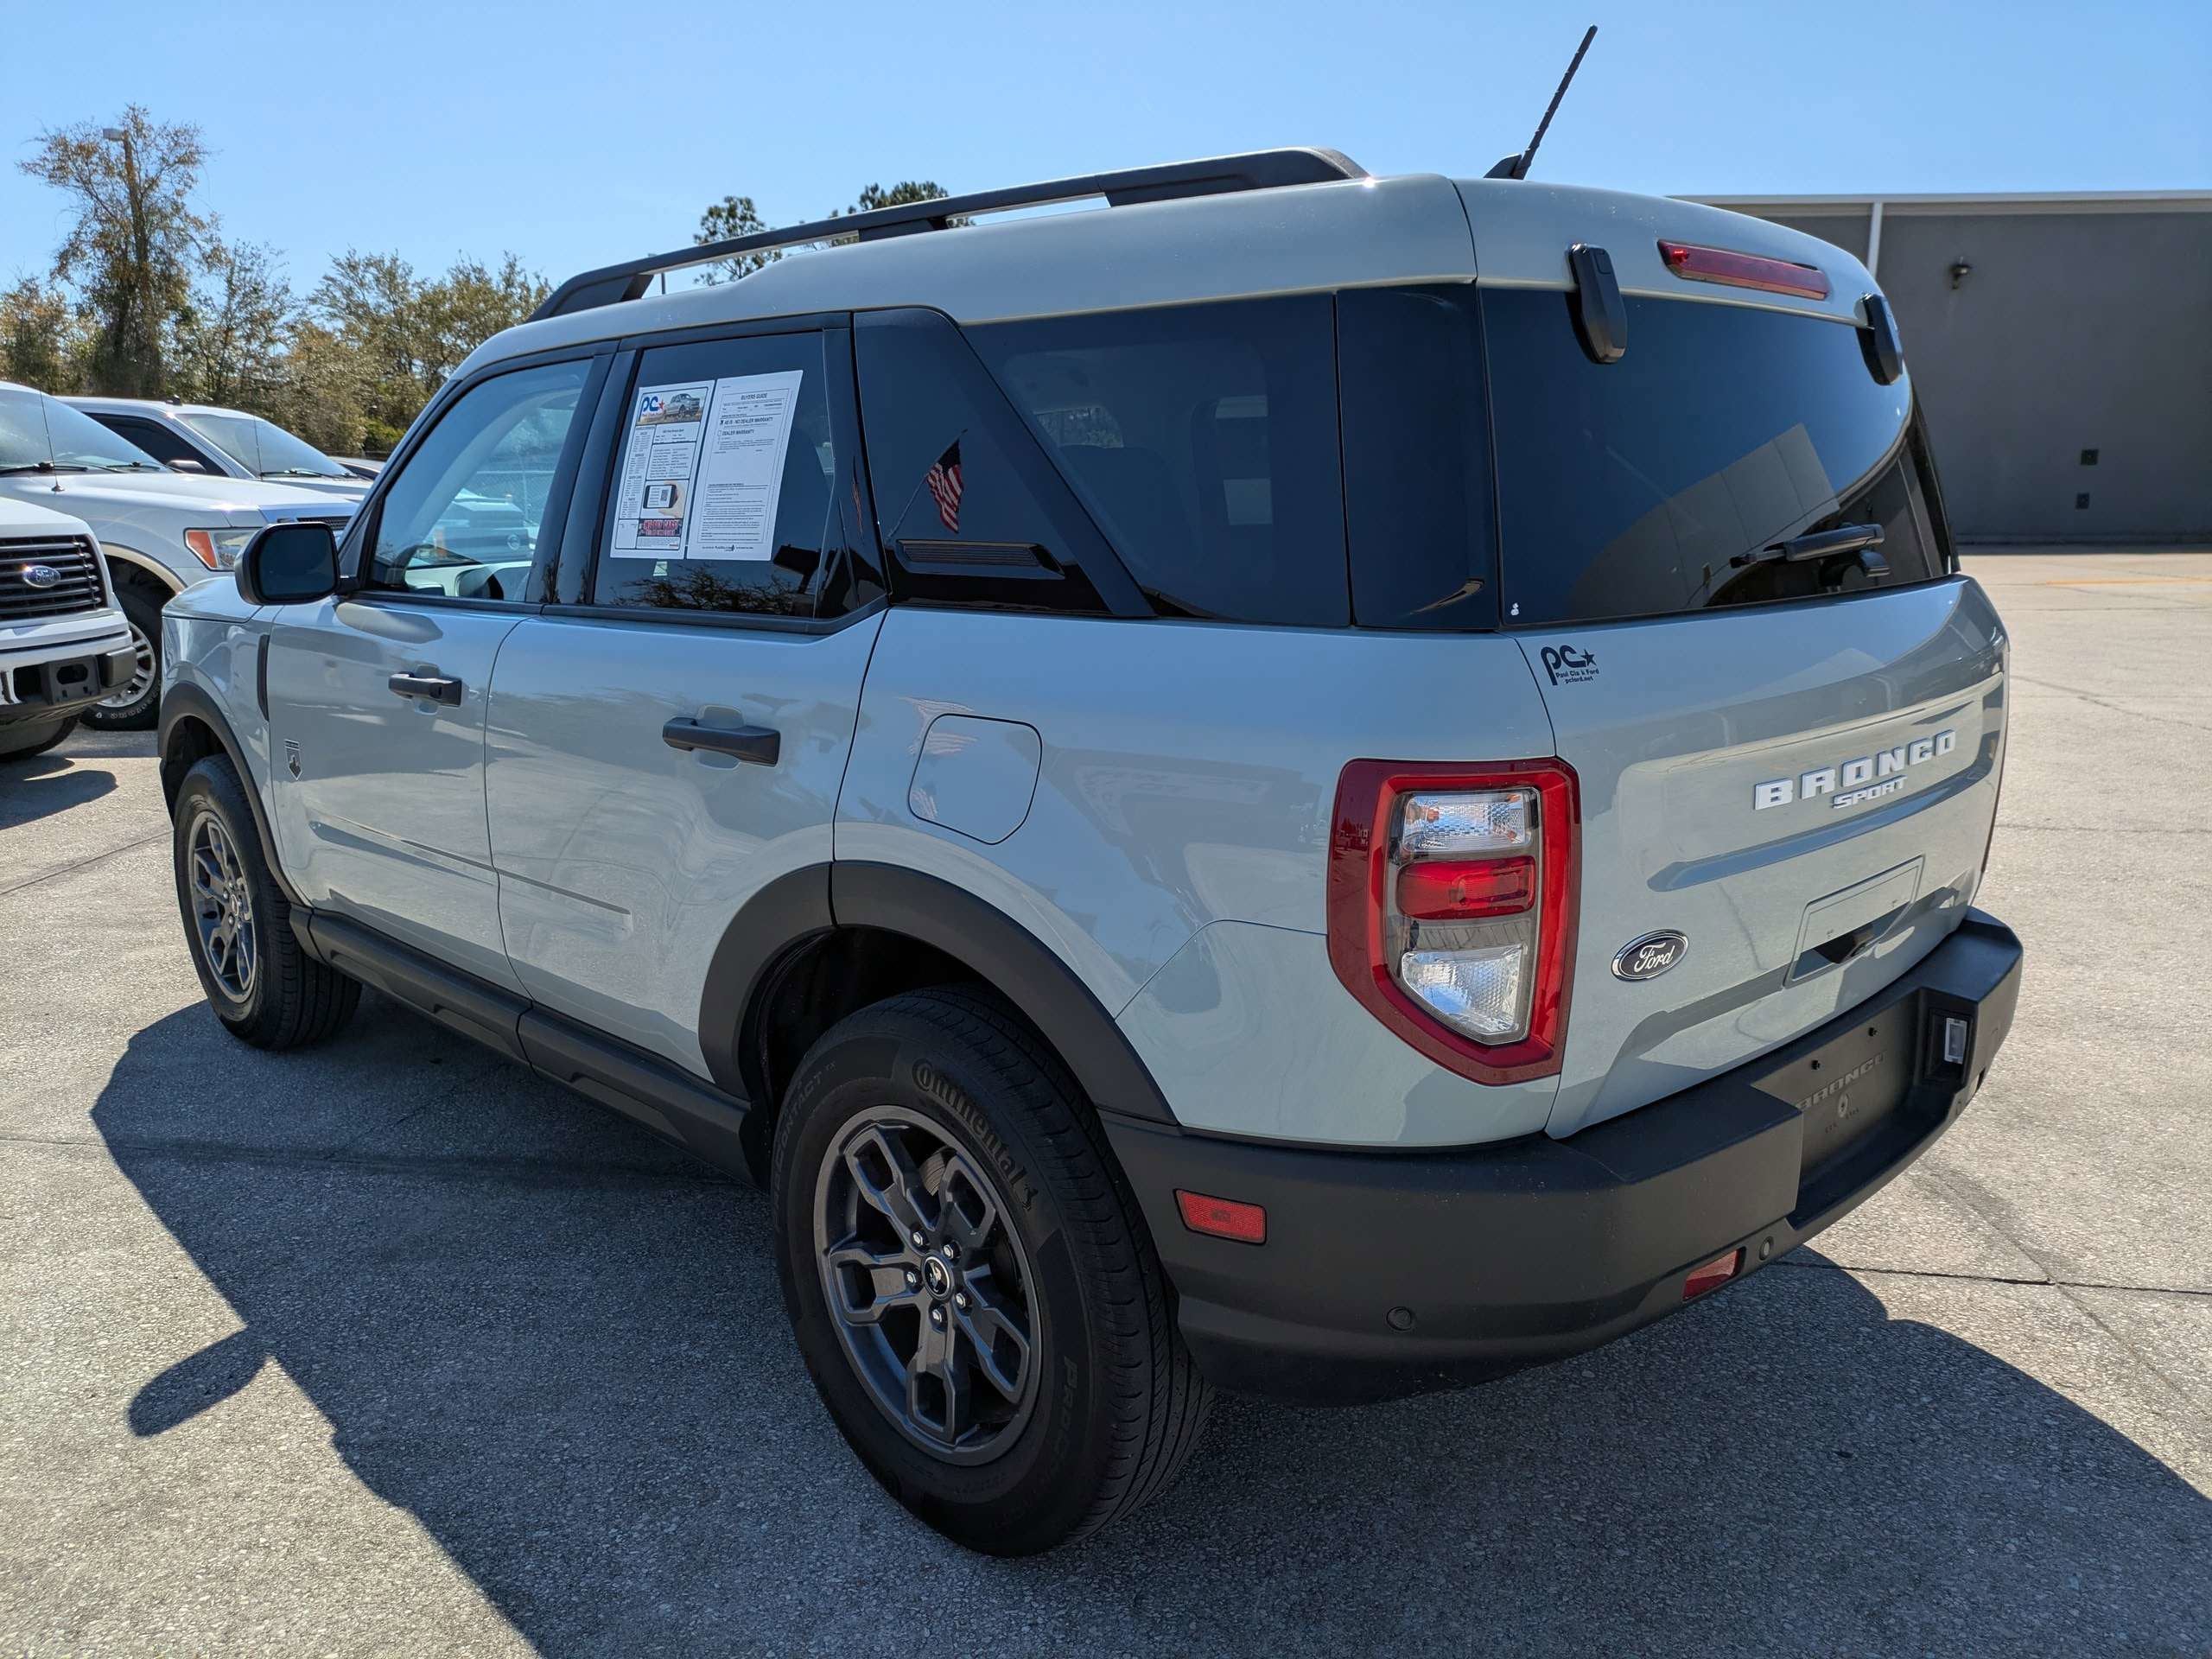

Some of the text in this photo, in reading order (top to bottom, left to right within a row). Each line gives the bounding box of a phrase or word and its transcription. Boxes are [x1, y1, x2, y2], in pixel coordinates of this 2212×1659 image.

[1754, 728, 1956, 810] BRONCO
[1831, 775, 1908, 810] SPORT
[1633, 942, 1675, 973] Ford
[1796, 1052, 1885, 1110] BRONCO
[912, 1058, 1028, 1186] Continental
